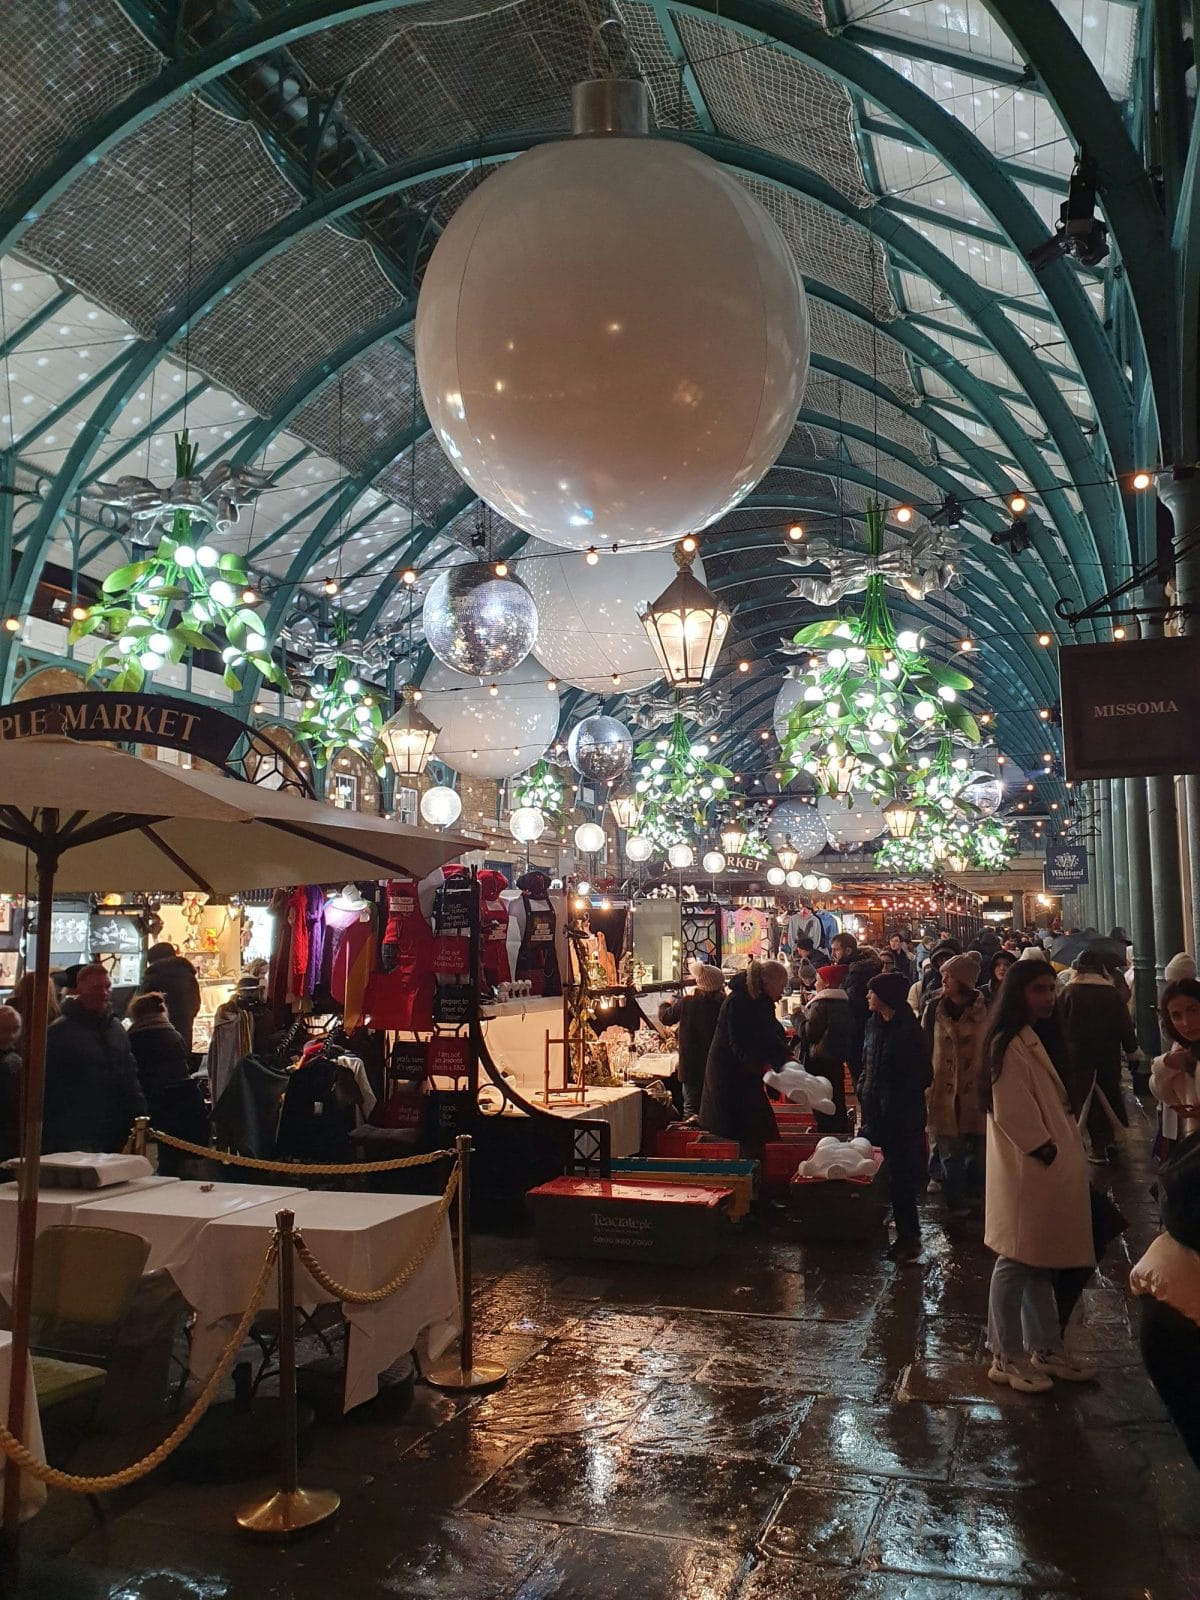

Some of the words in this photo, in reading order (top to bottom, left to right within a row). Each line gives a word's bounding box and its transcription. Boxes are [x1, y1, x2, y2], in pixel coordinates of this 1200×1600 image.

[1093, 699, 1179, 718] MISSOMA
[0, 708, 47, 740] PLE
[63, 703, 201, 741] MARKET
[727, 855, 762, 872] RKET
[1050, 867, 1084, 877] Whittard
